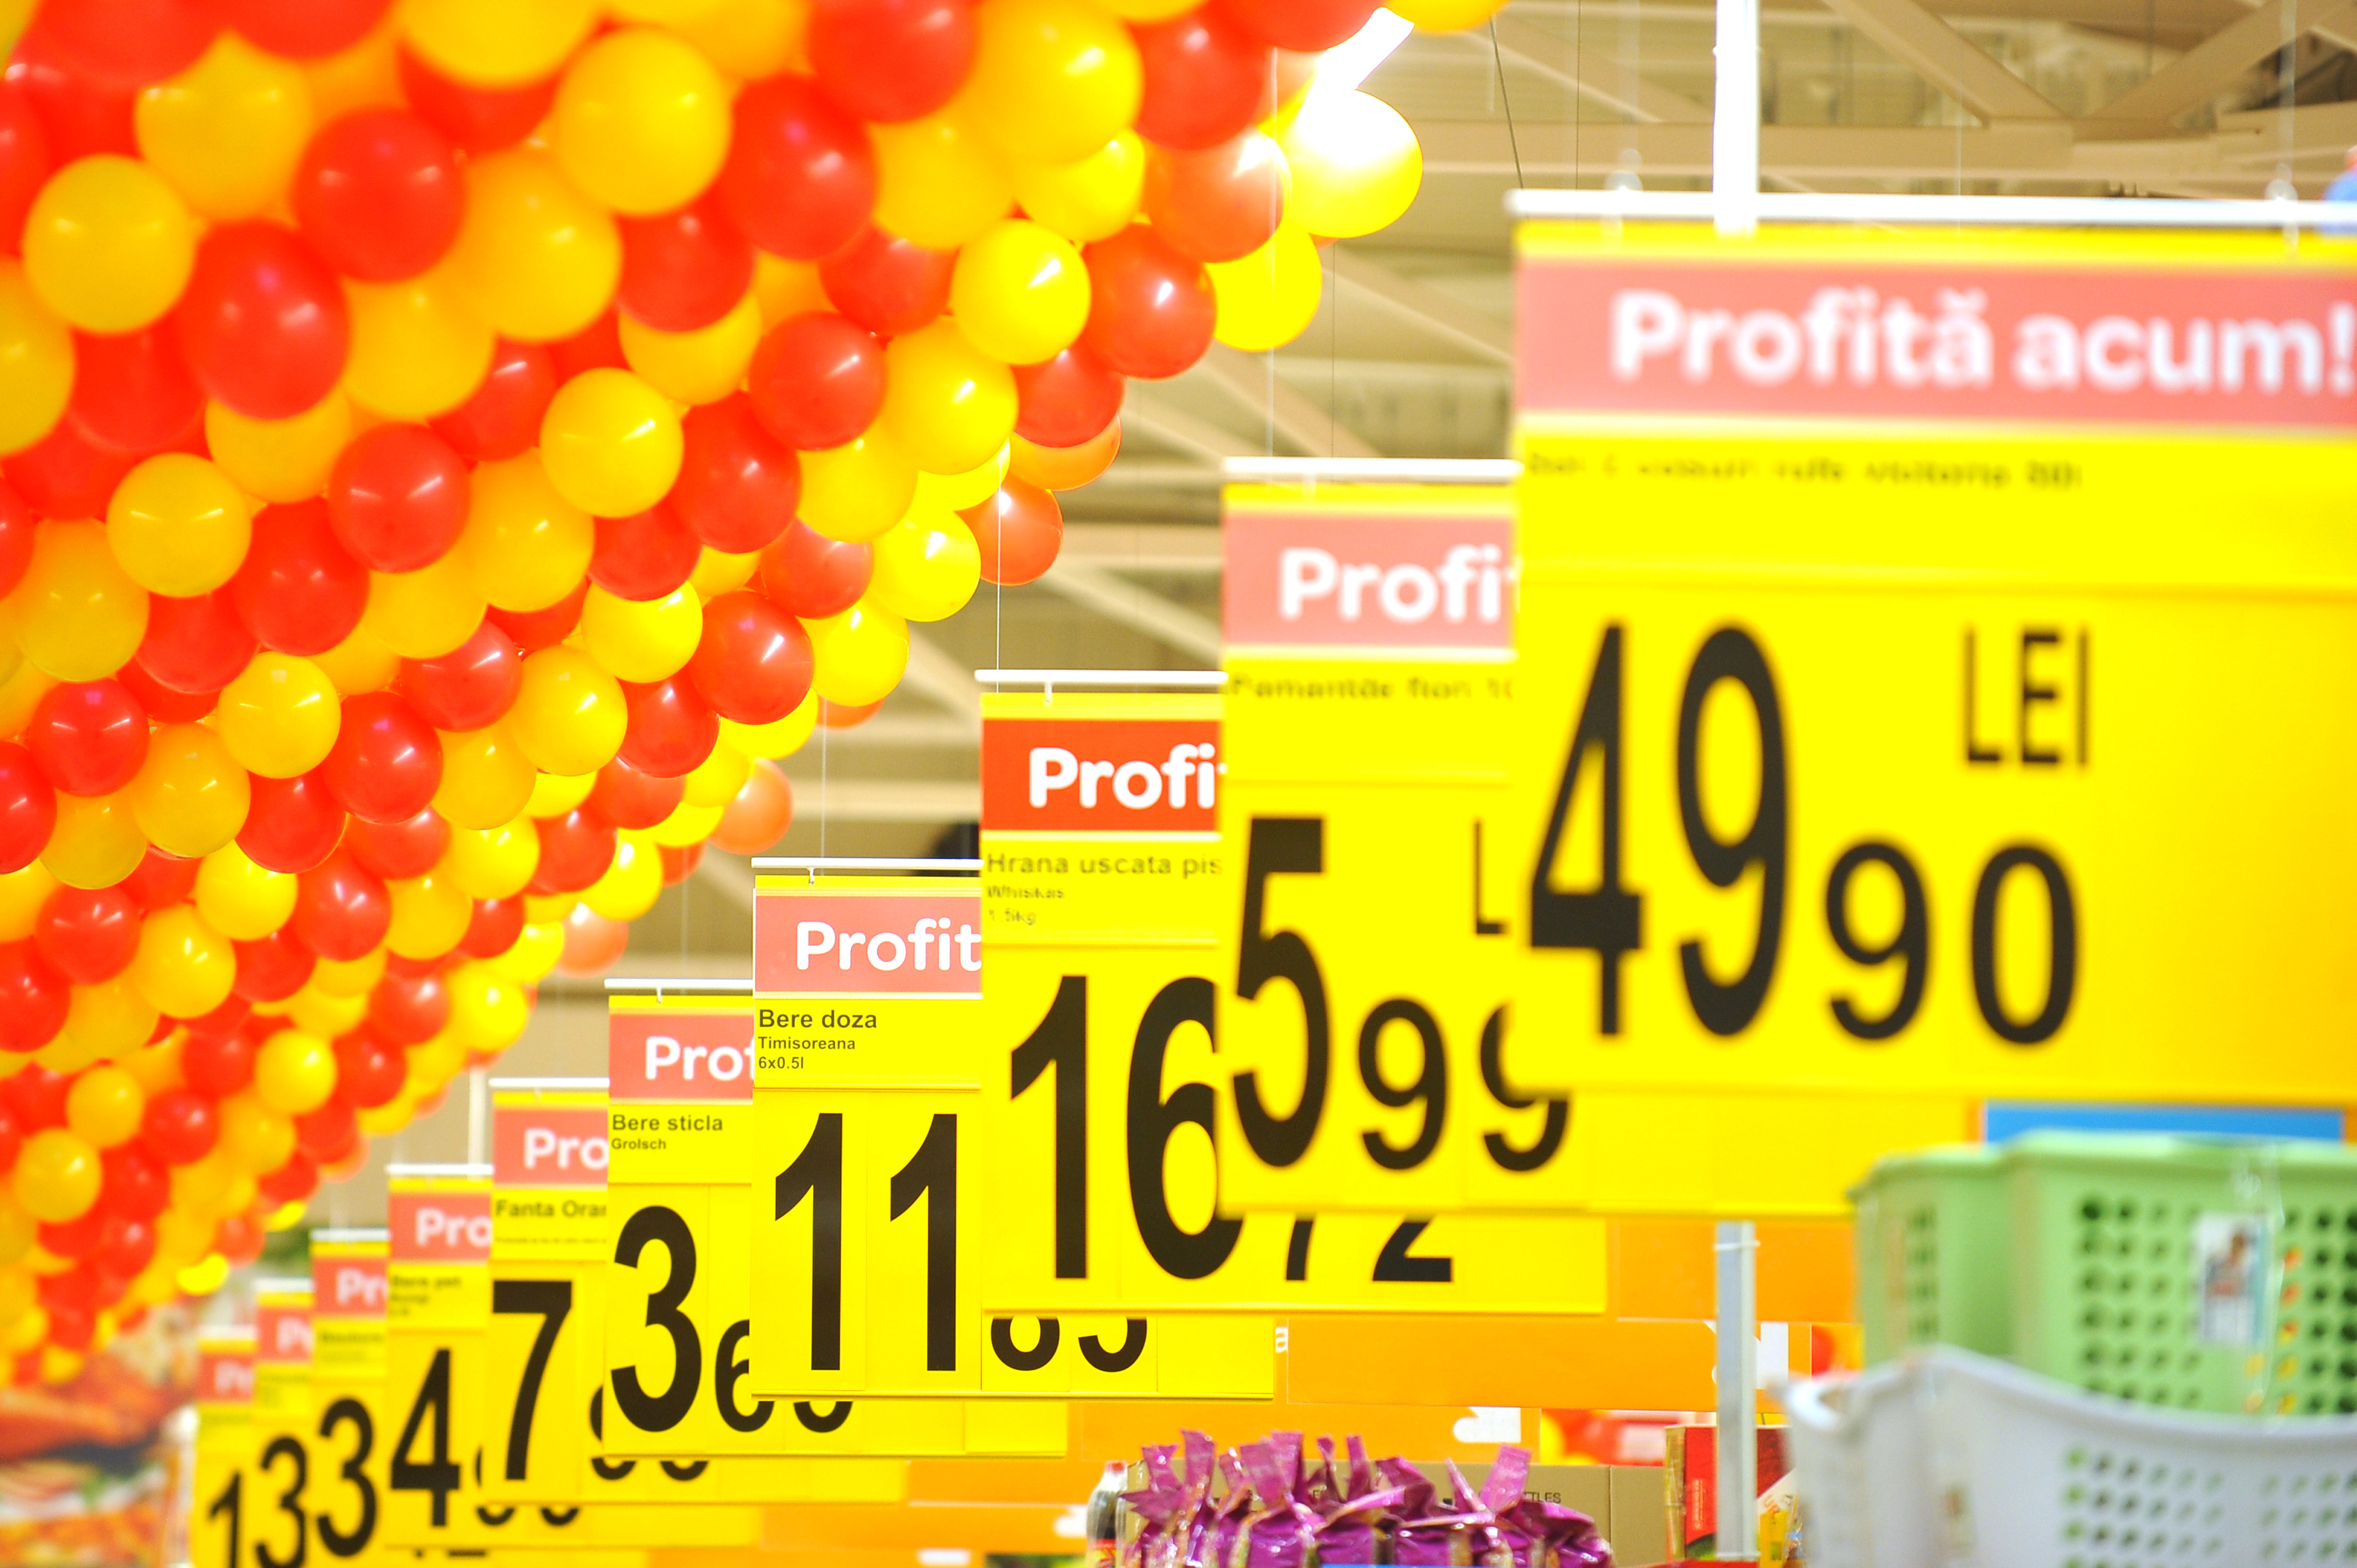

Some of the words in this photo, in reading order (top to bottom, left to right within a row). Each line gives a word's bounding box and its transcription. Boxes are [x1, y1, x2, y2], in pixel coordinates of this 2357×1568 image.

[1609, 286, 1994, 386] Profită
[2011, 303, 2357, 394] acum!
[1278, 543, 1519, 624] Profi
[1964, 627, 2088, 769] LEI
[1028, 742, 1221, 809] Profi
[987, 854, 1068, 874] Hrana
[1080, 856, 1171, 874] uscata
[1526, 621, 1792, 1041] 49
[1822, 837, 2081, 1049] 90
[987, 885, 1064, 899] Whiskas
[758, 1036, 856, 1050] Timisoreana
[759, 1009, 813, 1028] Bere
[821, 1009, 877, 1029] doza
[1230, 814, 1333, 1170] 5
[1356, 996, 1571, 1174] 99
[611, 1137, 667, 1150] Grolsch
[612, 1114, 660, 1131] Bere
[667, 1115, 723, 1131] sticla
[1010, 974, 1245, 1281] 16
[495, 1199, 555, 1218] Fanta
[775, 1112, 958, 1371] 11
[610, 1205, 702, 1433] 3
[492, 1278, 573, 1482] 7
[313, 1396, 379, 1559] 3
[389, 1347, 462, 1528] 4
